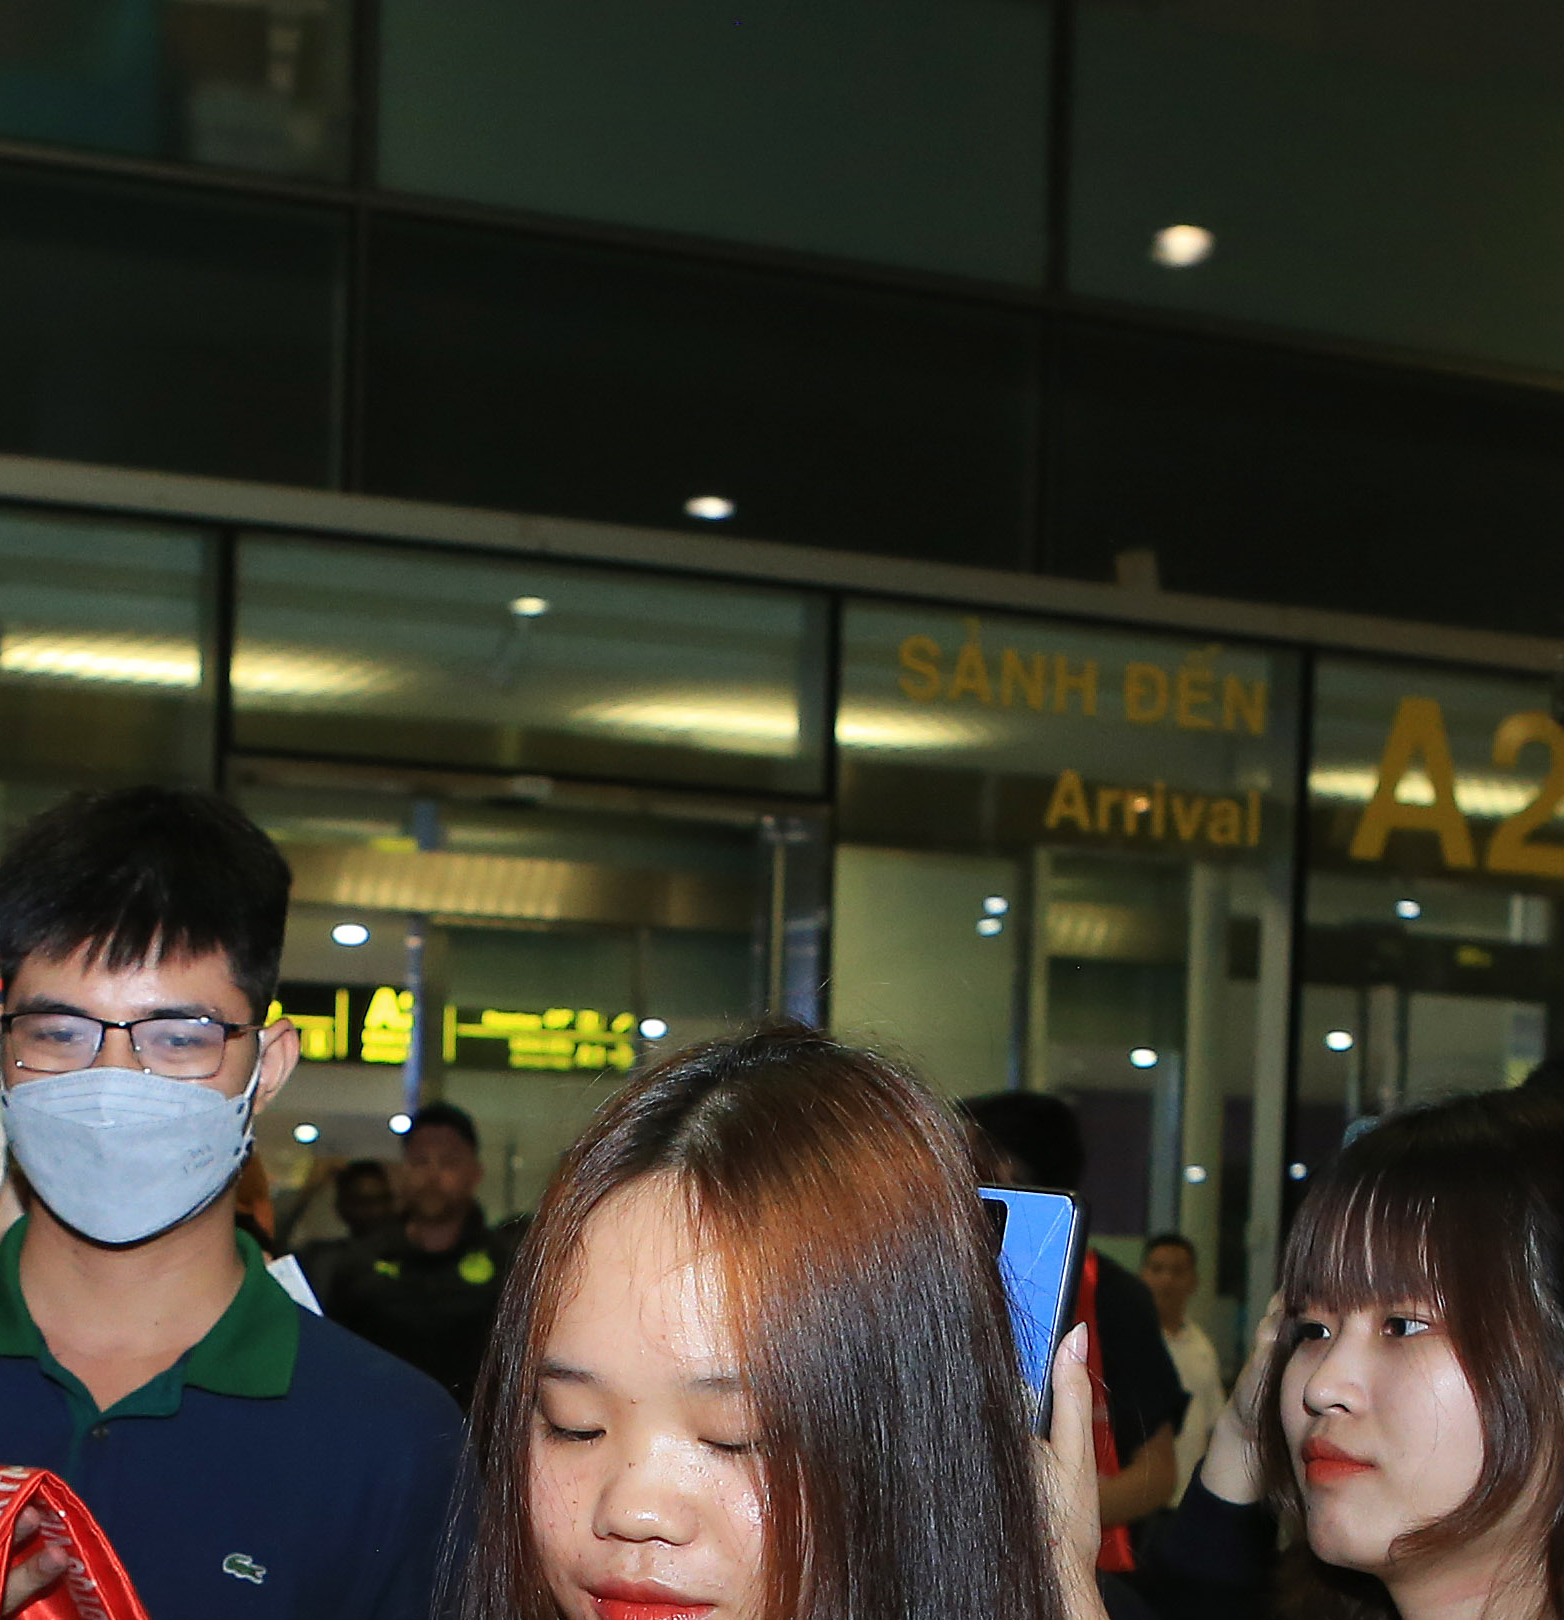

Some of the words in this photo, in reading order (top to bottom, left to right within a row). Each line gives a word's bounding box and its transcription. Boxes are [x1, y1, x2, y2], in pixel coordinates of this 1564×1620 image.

[898, 618, 1099, 717] SẢNH
[1123, 644, 1269, 736] ĐẾN
[1043, 768, 1262, 847] Arrival
